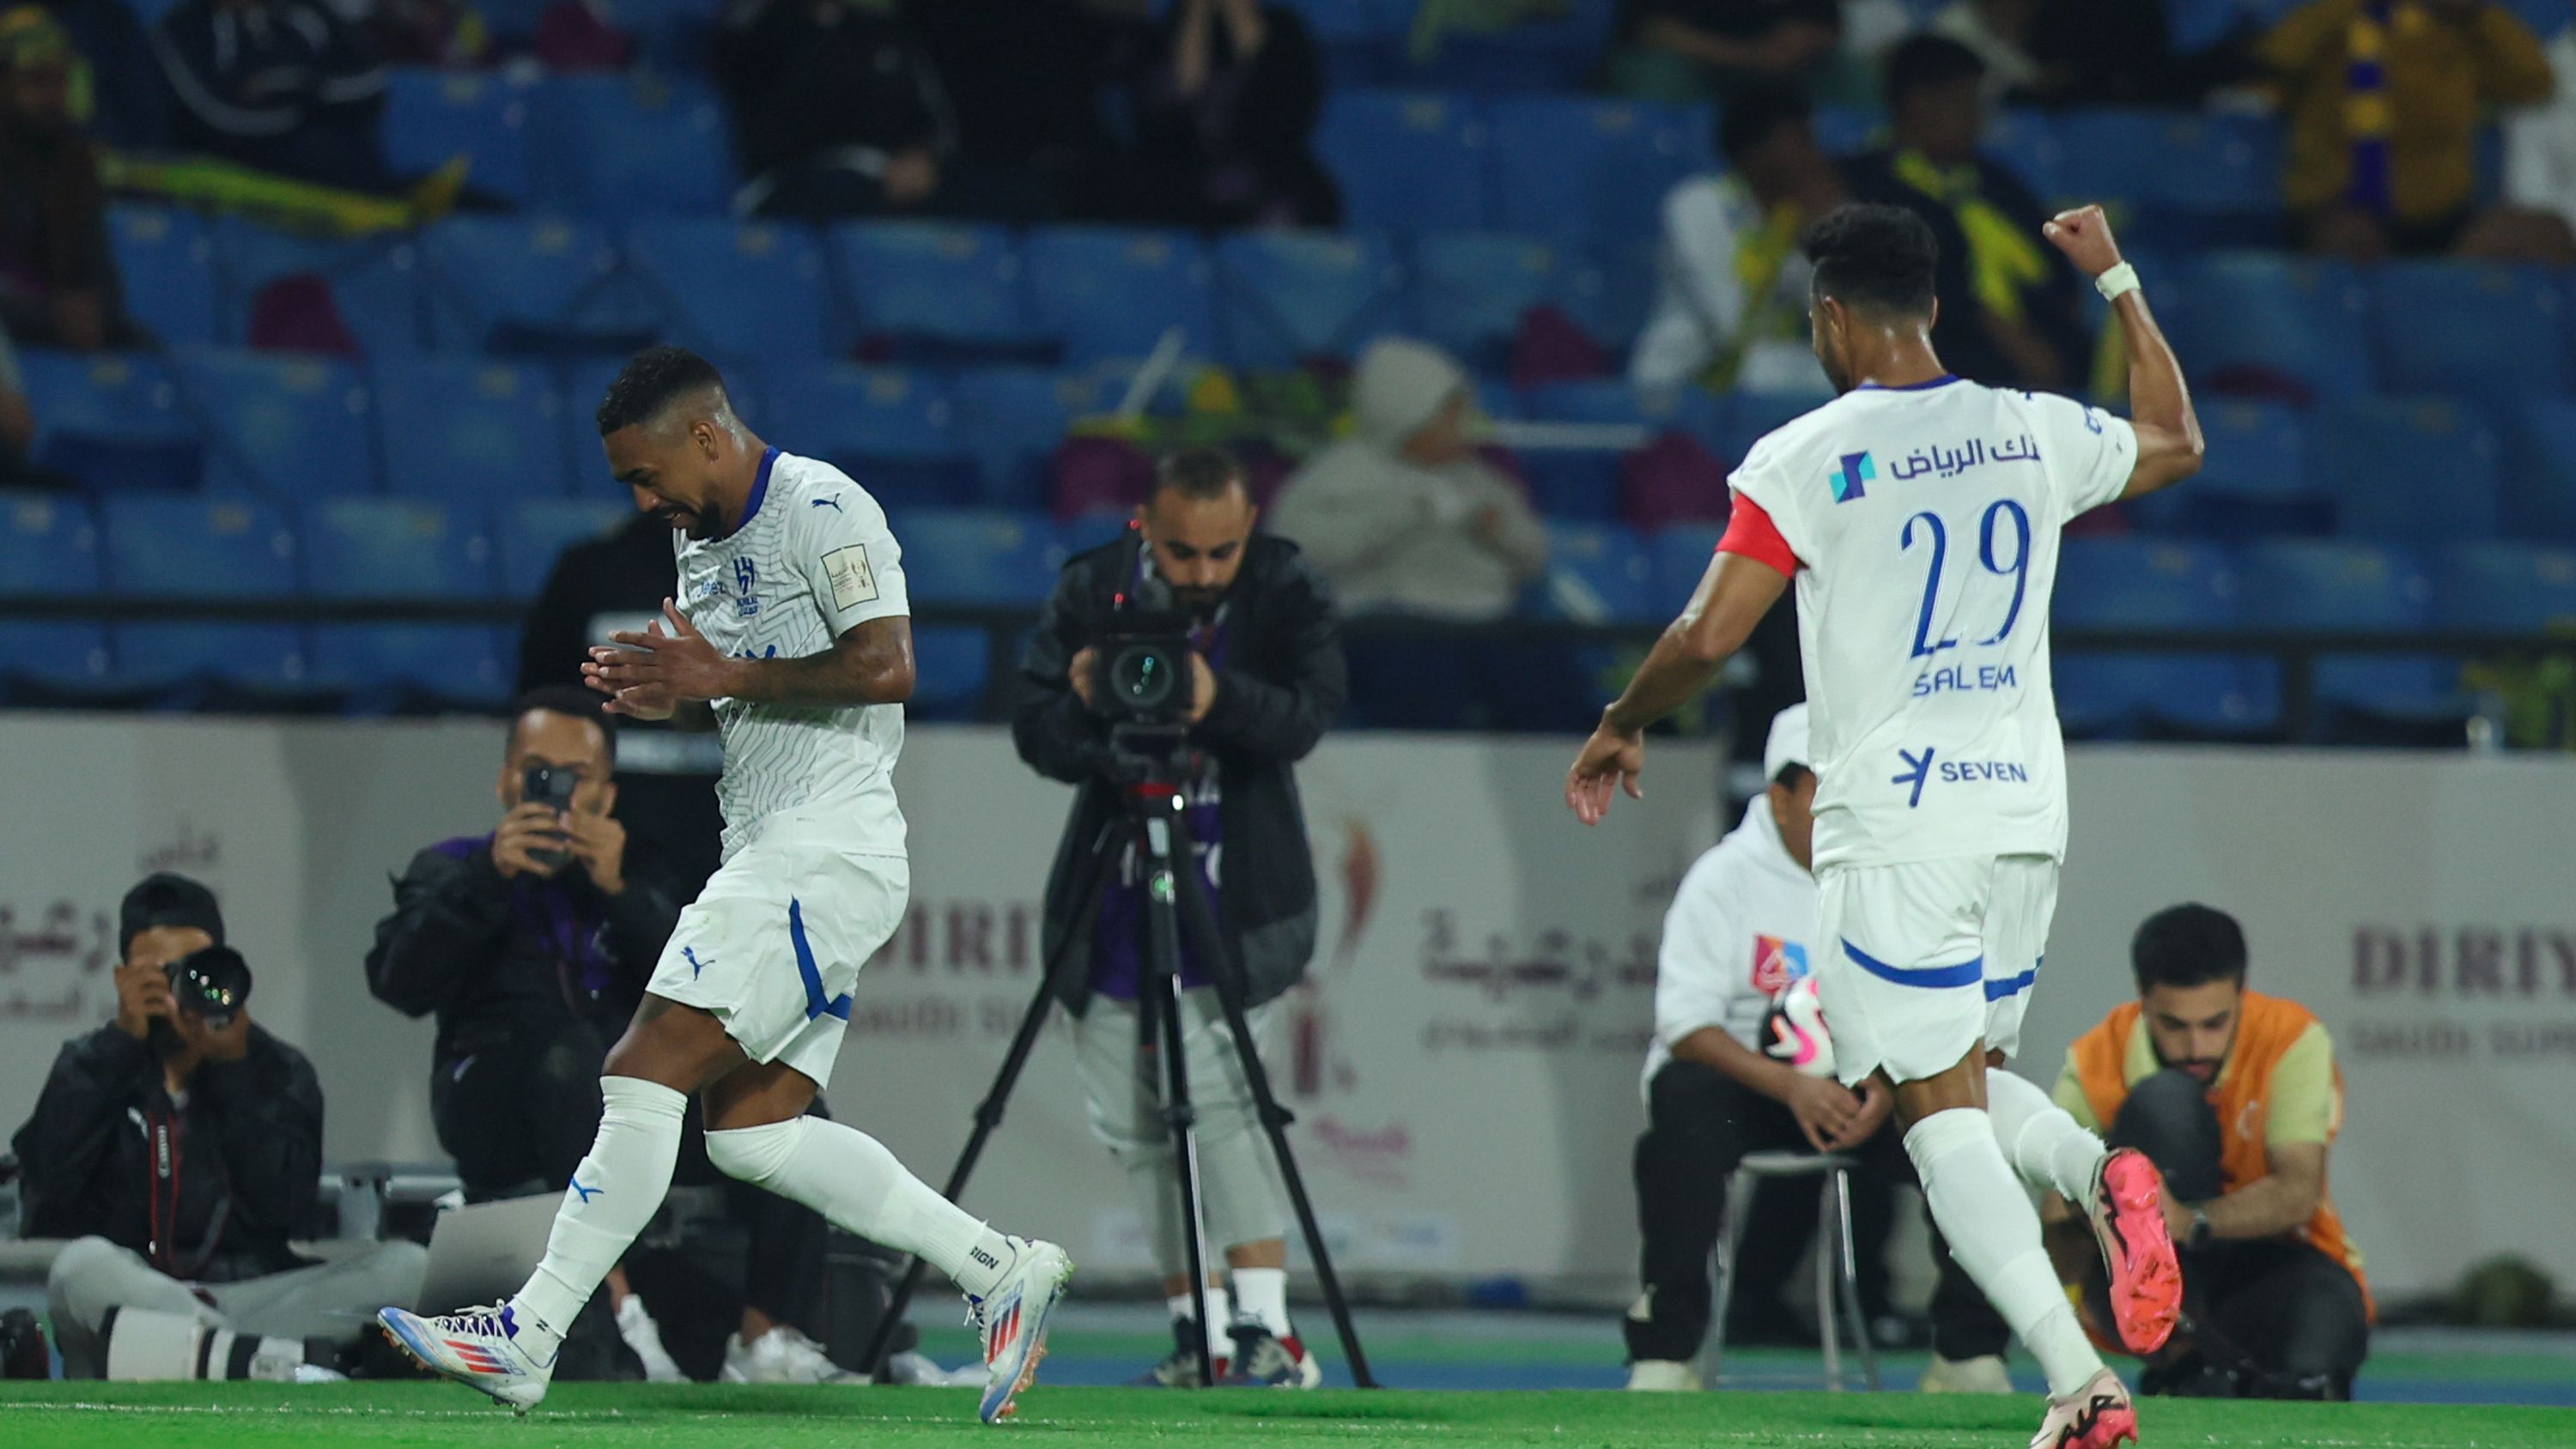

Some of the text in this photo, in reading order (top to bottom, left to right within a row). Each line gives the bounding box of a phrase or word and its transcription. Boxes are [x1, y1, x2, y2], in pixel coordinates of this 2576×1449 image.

[1890, 438, 1984, 481] الرياض
[1899, 498, 2032, 660] 29
[1911, 664, 2017, 698] SALEM
[1940, 761, 2029, 783] SEVEN
